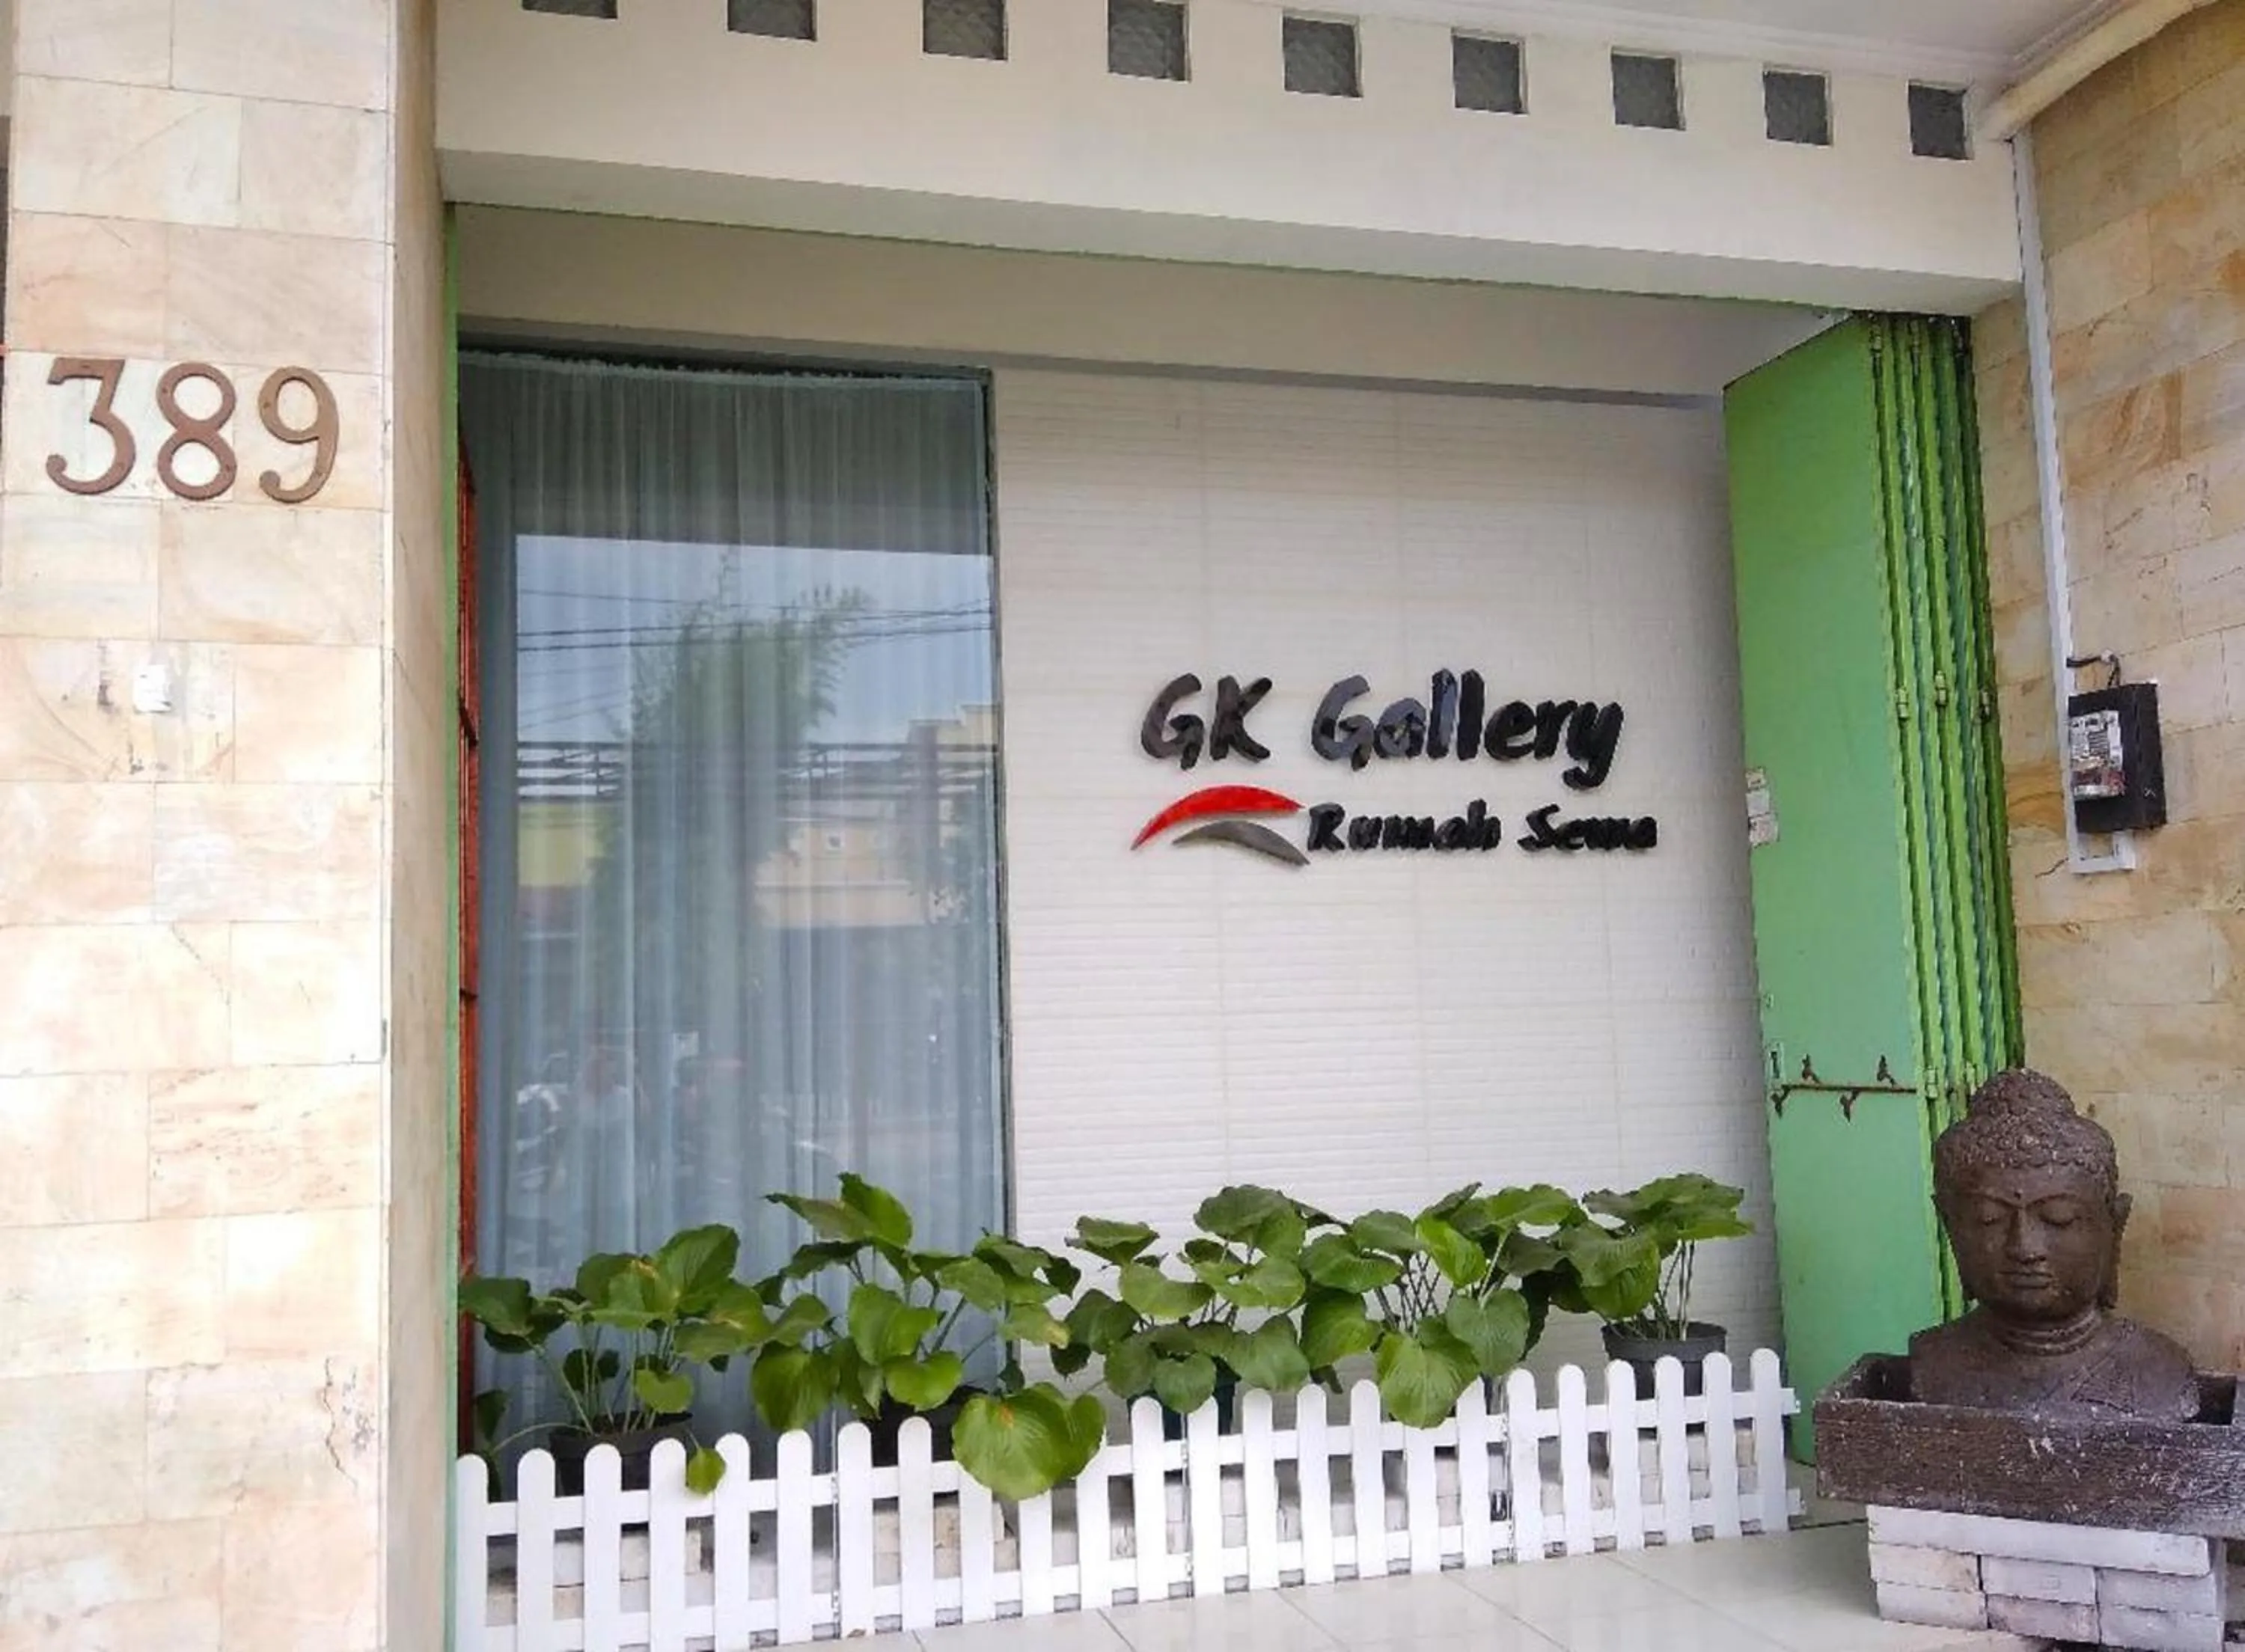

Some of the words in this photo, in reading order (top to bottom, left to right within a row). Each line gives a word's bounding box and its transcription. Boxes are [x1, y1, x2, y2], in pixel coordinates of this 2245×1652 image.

[46, 356, 340, 504] 389
[1140, 673, 1273, 771] GK
[1310, 668, 1625, 792] Gallery
[1307, 798, 1502, 853] Rumah
